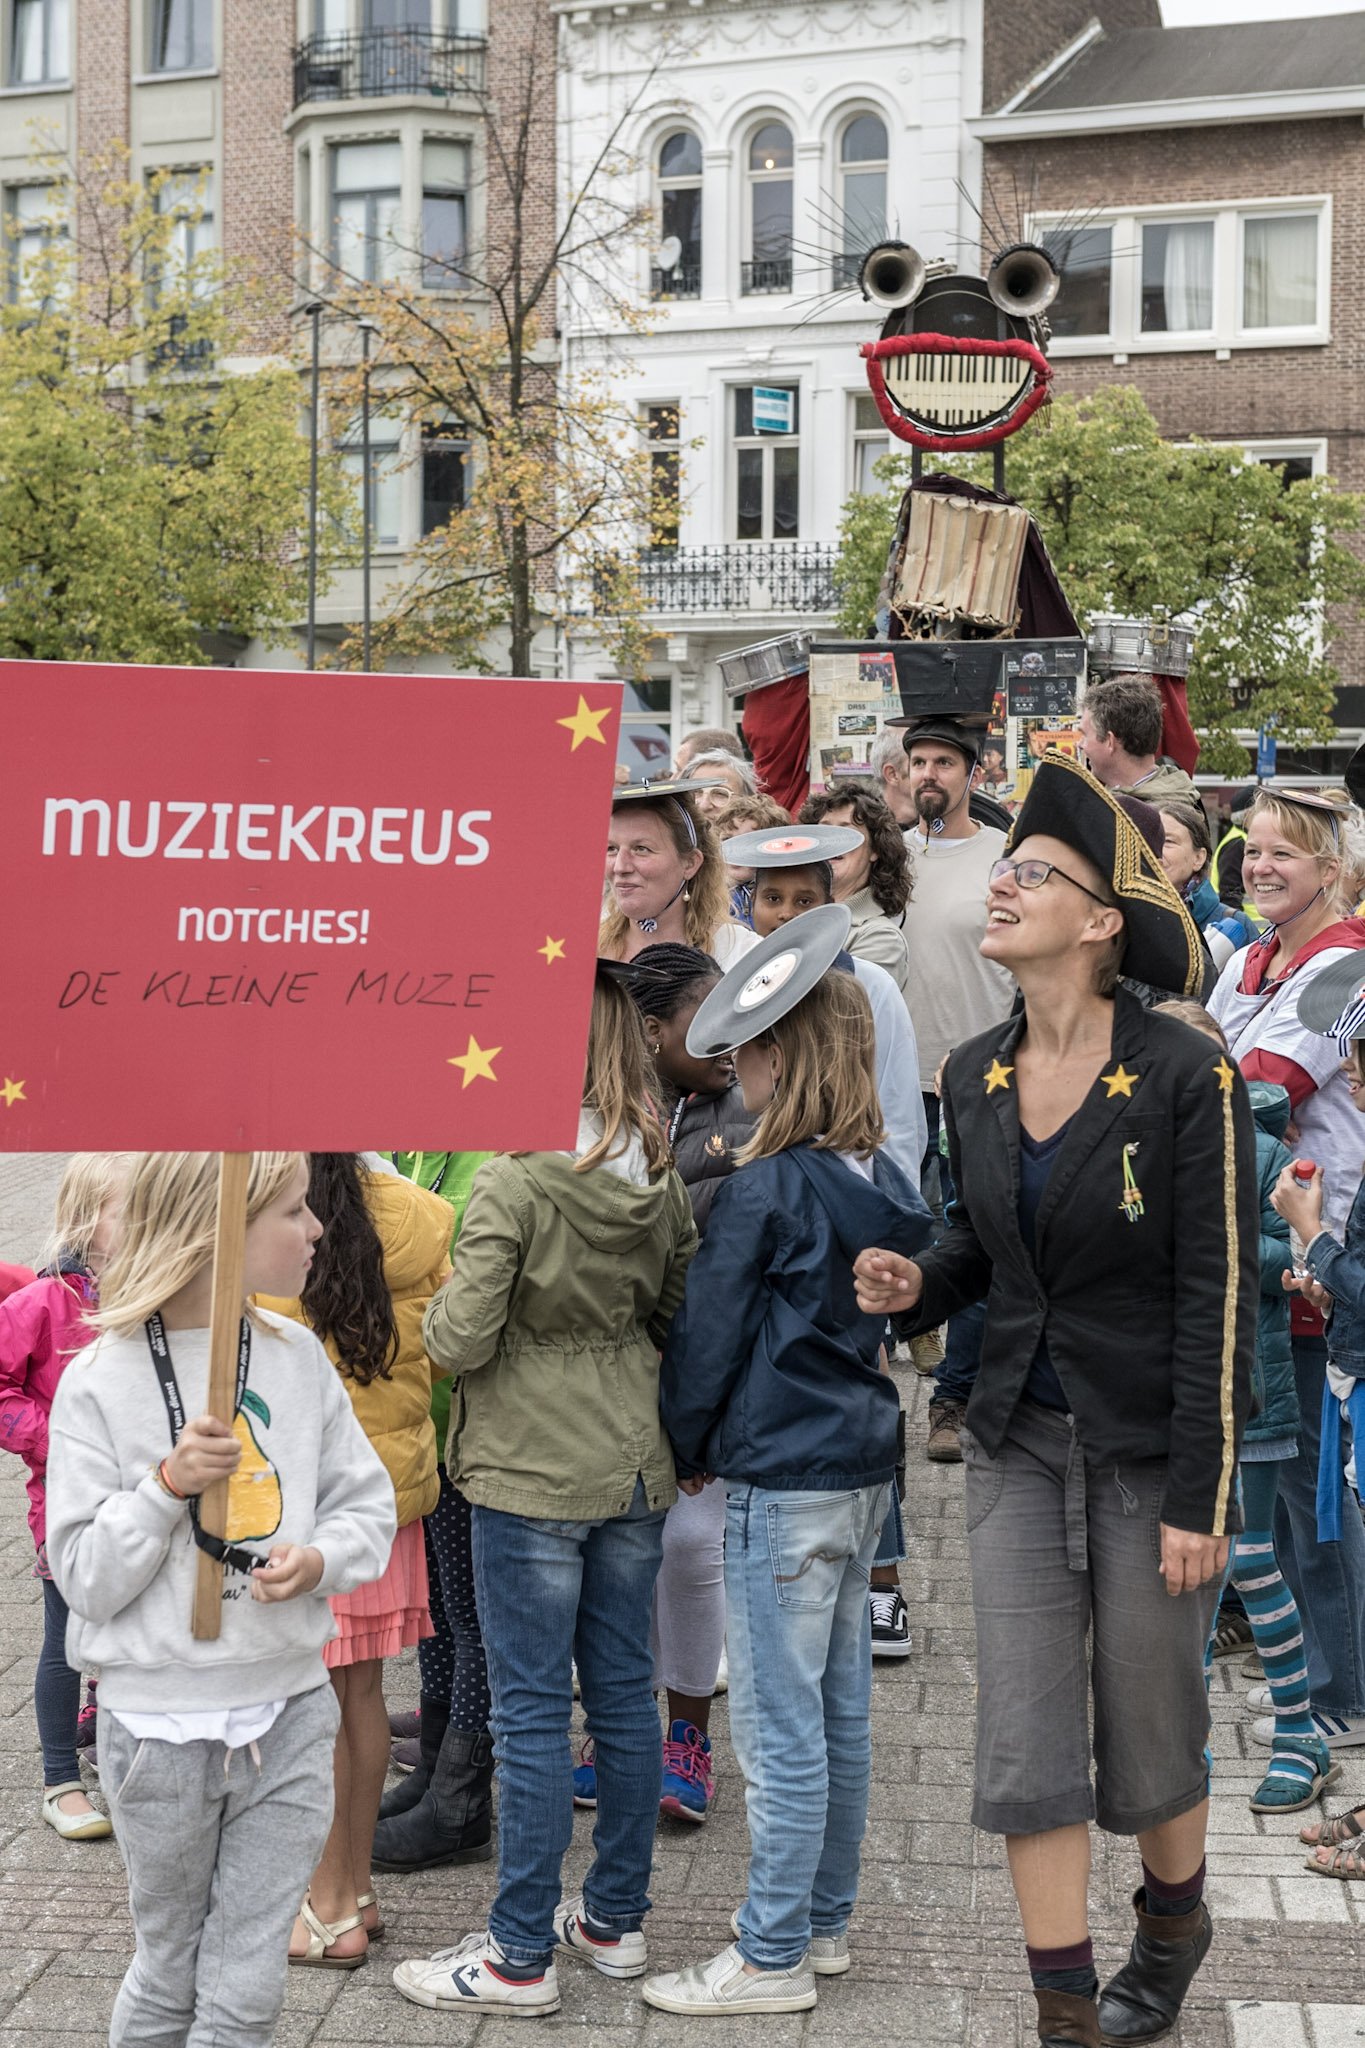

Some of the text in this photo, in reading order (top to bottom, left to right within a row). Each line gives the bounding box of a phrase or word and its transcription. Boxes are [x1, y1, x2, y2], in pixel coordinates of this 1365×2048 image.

[177, 906, 370, 945] NOTCHES!
[58, 964, 496, 1009] DE KLEINE MUZE
[165, 1381, 180, 1409] dienst
[173, 1409, 184, 1429] van
